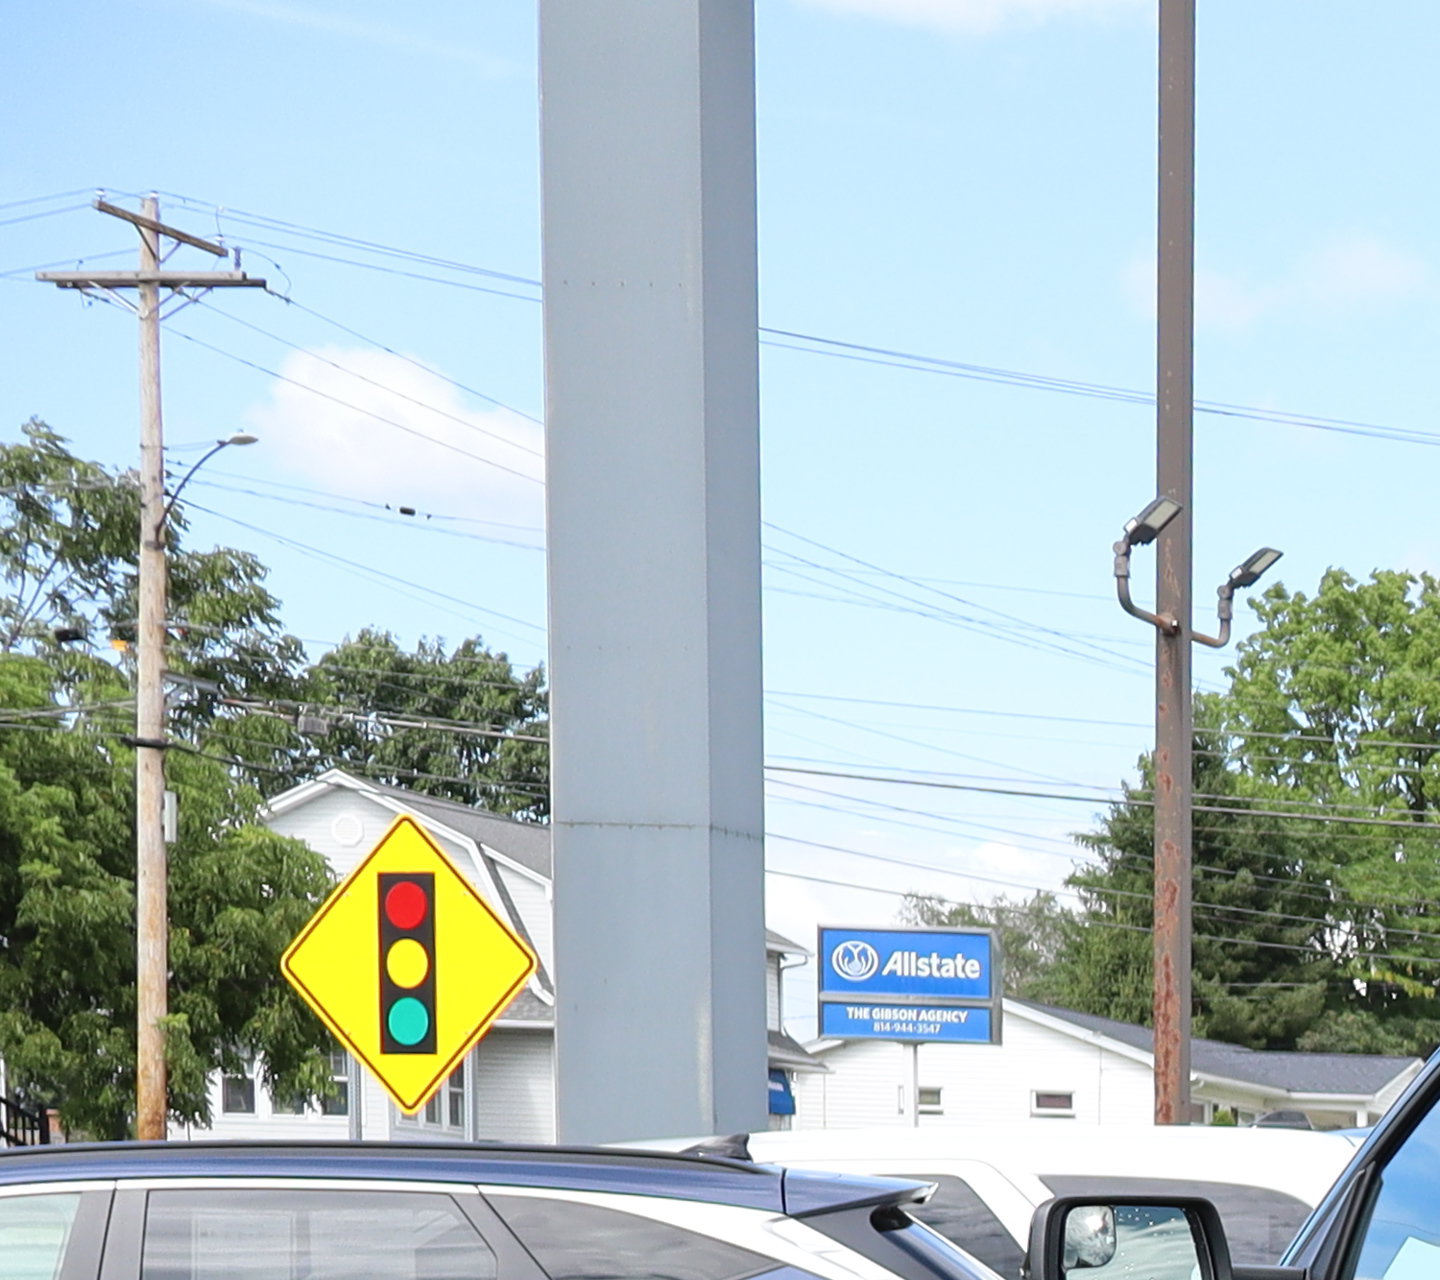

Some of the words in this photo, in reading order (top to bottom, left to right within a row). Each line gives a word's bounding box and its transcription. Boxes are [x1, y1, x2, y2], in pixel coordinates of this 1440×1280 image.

[882, 951, 981, 979] Allstate
[846, 1006, 870, 1020] THE
[872, 1007, 917, 1021] GIBSON
[918, 1009, 968, 1023] AGENCY
